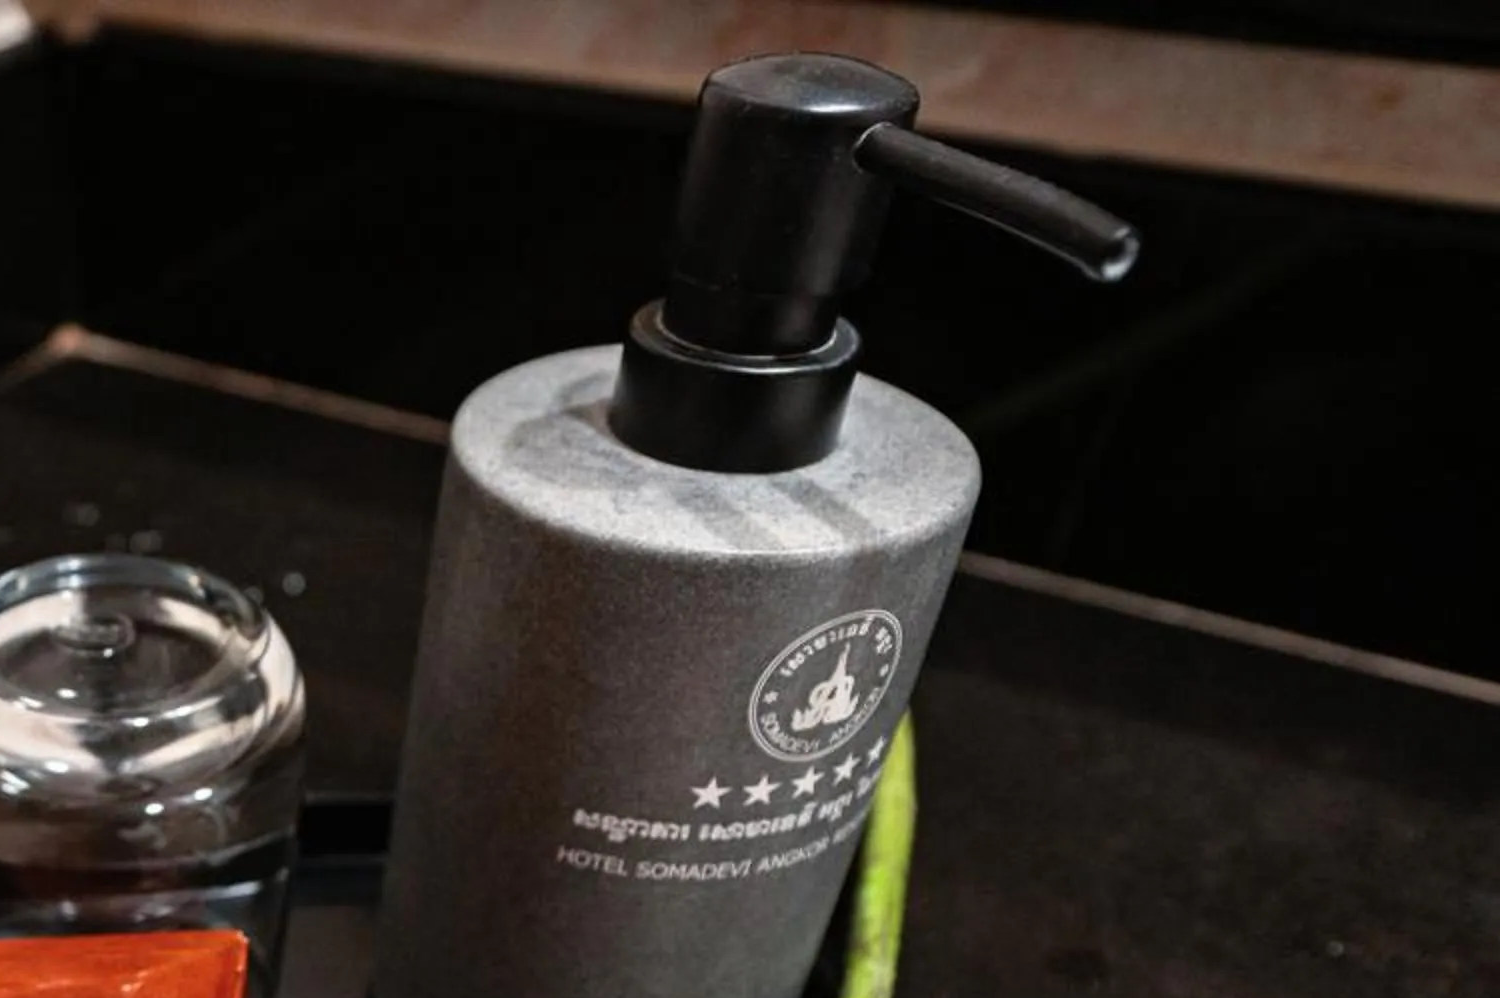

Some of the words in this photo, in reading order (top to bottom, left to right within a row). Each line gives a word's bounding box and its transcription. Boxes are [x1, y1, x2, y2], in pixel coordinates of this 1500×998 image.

[556, 845, 628, 877] HOTEL
[635, 859, 752, 881] SOMADEVI
[756, 836, 830, 873] ANGKOR
